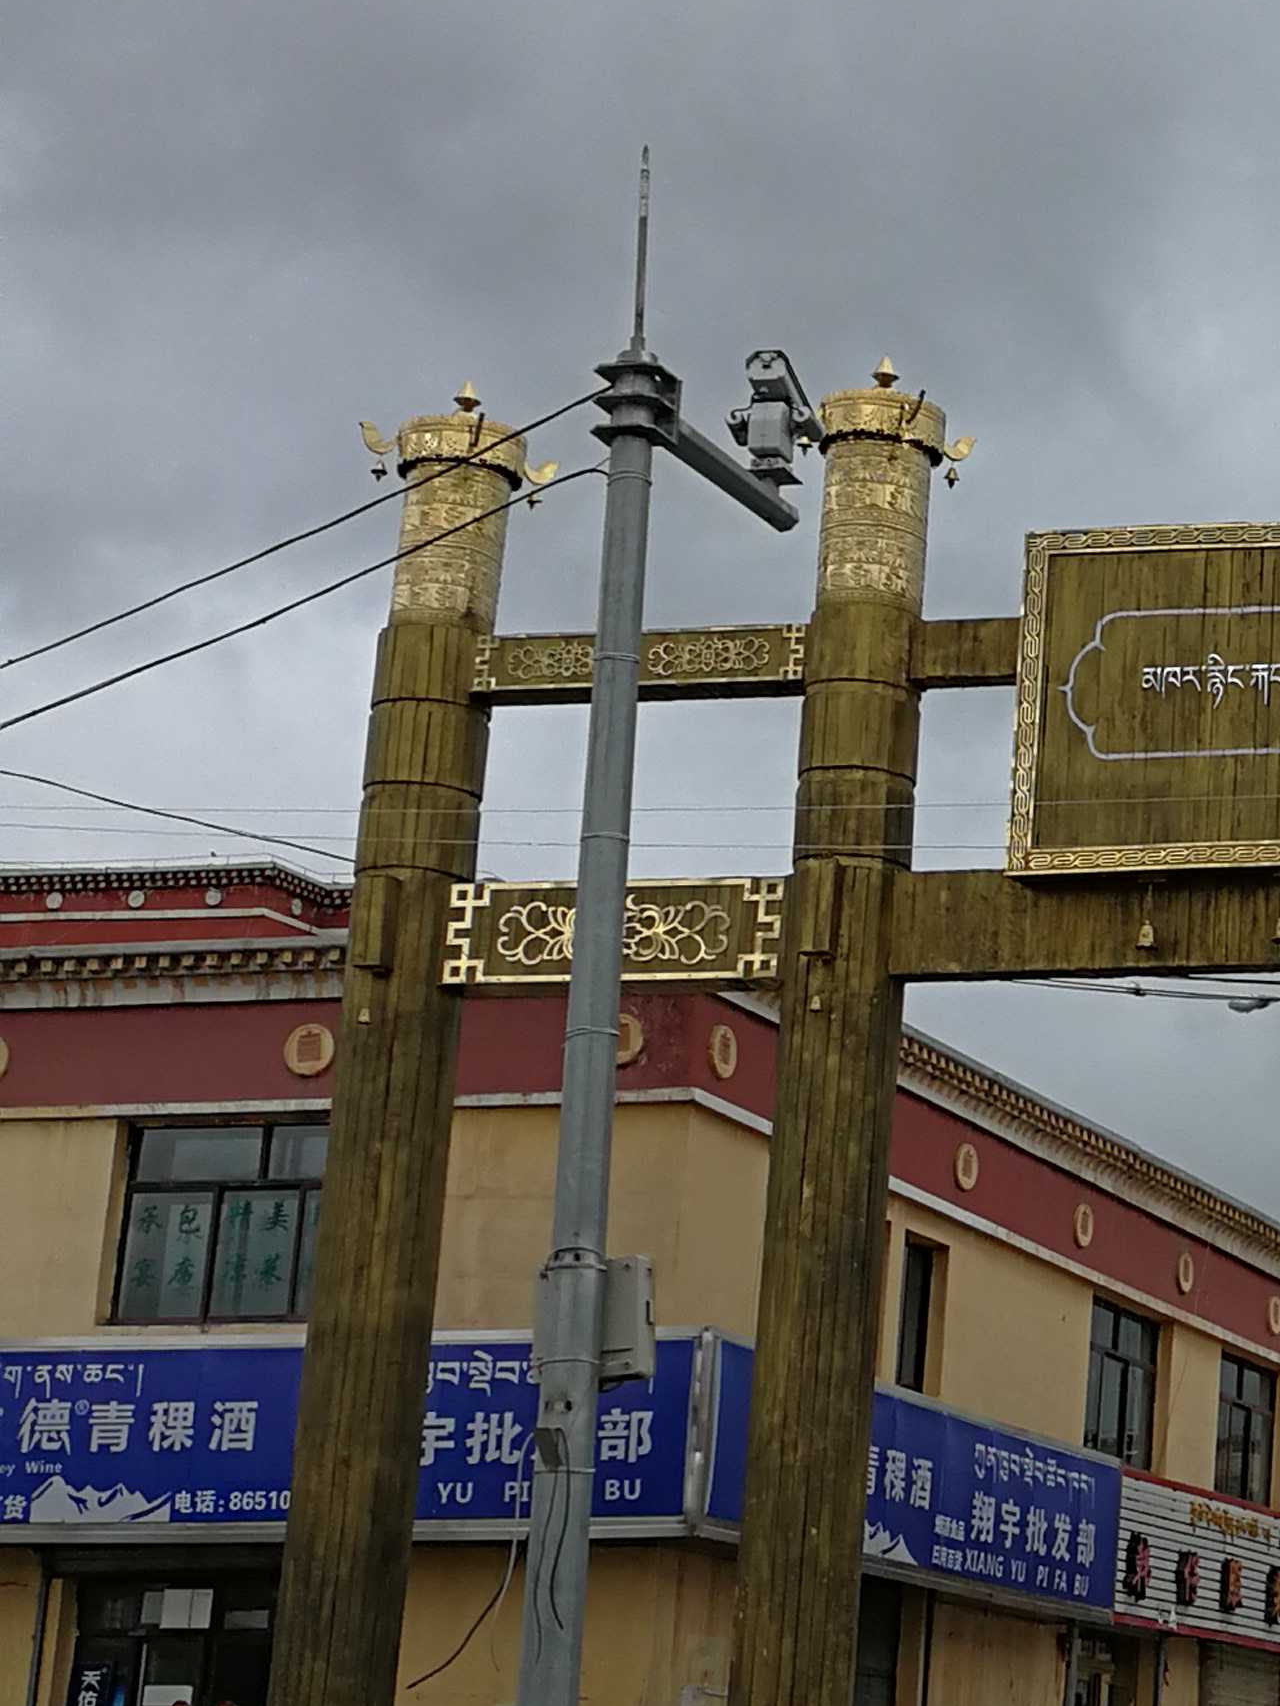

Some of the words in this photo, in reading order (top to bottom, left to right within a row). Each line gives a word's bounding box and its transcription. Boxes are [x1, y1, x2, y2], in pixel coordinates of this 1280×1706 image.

[419, 1408, 655, 1466] 宇批部
[25, 1461, 63, 1475] Wine
[0, 1494, 27, 1520] 货
[437, 1482, 474, 1504] YU
[503, 1481, 532, 1503] PI
[604, 1479, 642, 1501] BU
[970, 1490, 1097, 1569] 翔宇批发部
[964, 1548, 1004, 1578] XIANG
[1010, 1559, 1026, 1583] YU
[1036, 1565, 1048, 1588] PI
[1053, 1569, 1068, 1593] FA
